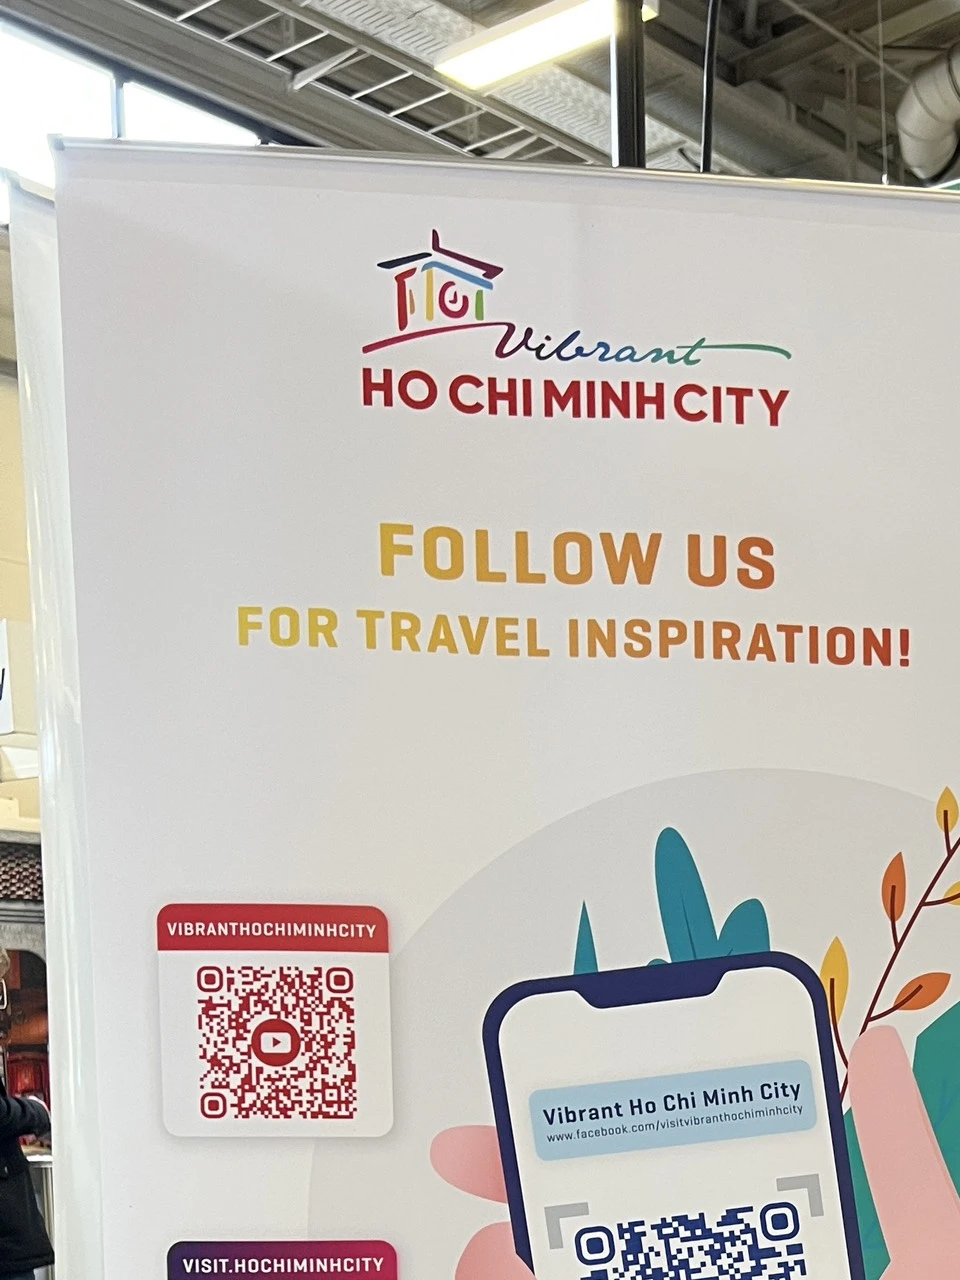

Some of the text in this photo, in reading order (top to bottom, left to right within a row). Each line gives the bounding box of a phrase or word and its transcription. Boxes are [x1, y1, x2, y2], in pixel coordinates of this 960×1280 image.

[495, 320, 791, 366] Vibrant
[363, 368, 789, 426] HO CHI MINH CITY
[380, 523, 774, 589] FOLLOW US
[237, 606, 909, 667] FOR TRAVEL INSPIRATION!
[167, 922, 376, 938] VIBRANTHOCHIMINHCITY
[543, 1082, 800, 1125] Vibrant Ho Chi Minh City
[546, 1104, 804, 1143] www.facebook.com/visitvibranthochiminhcity
[183, 1257, 383, 1273] VISIT.HOCHIMINHCITY
